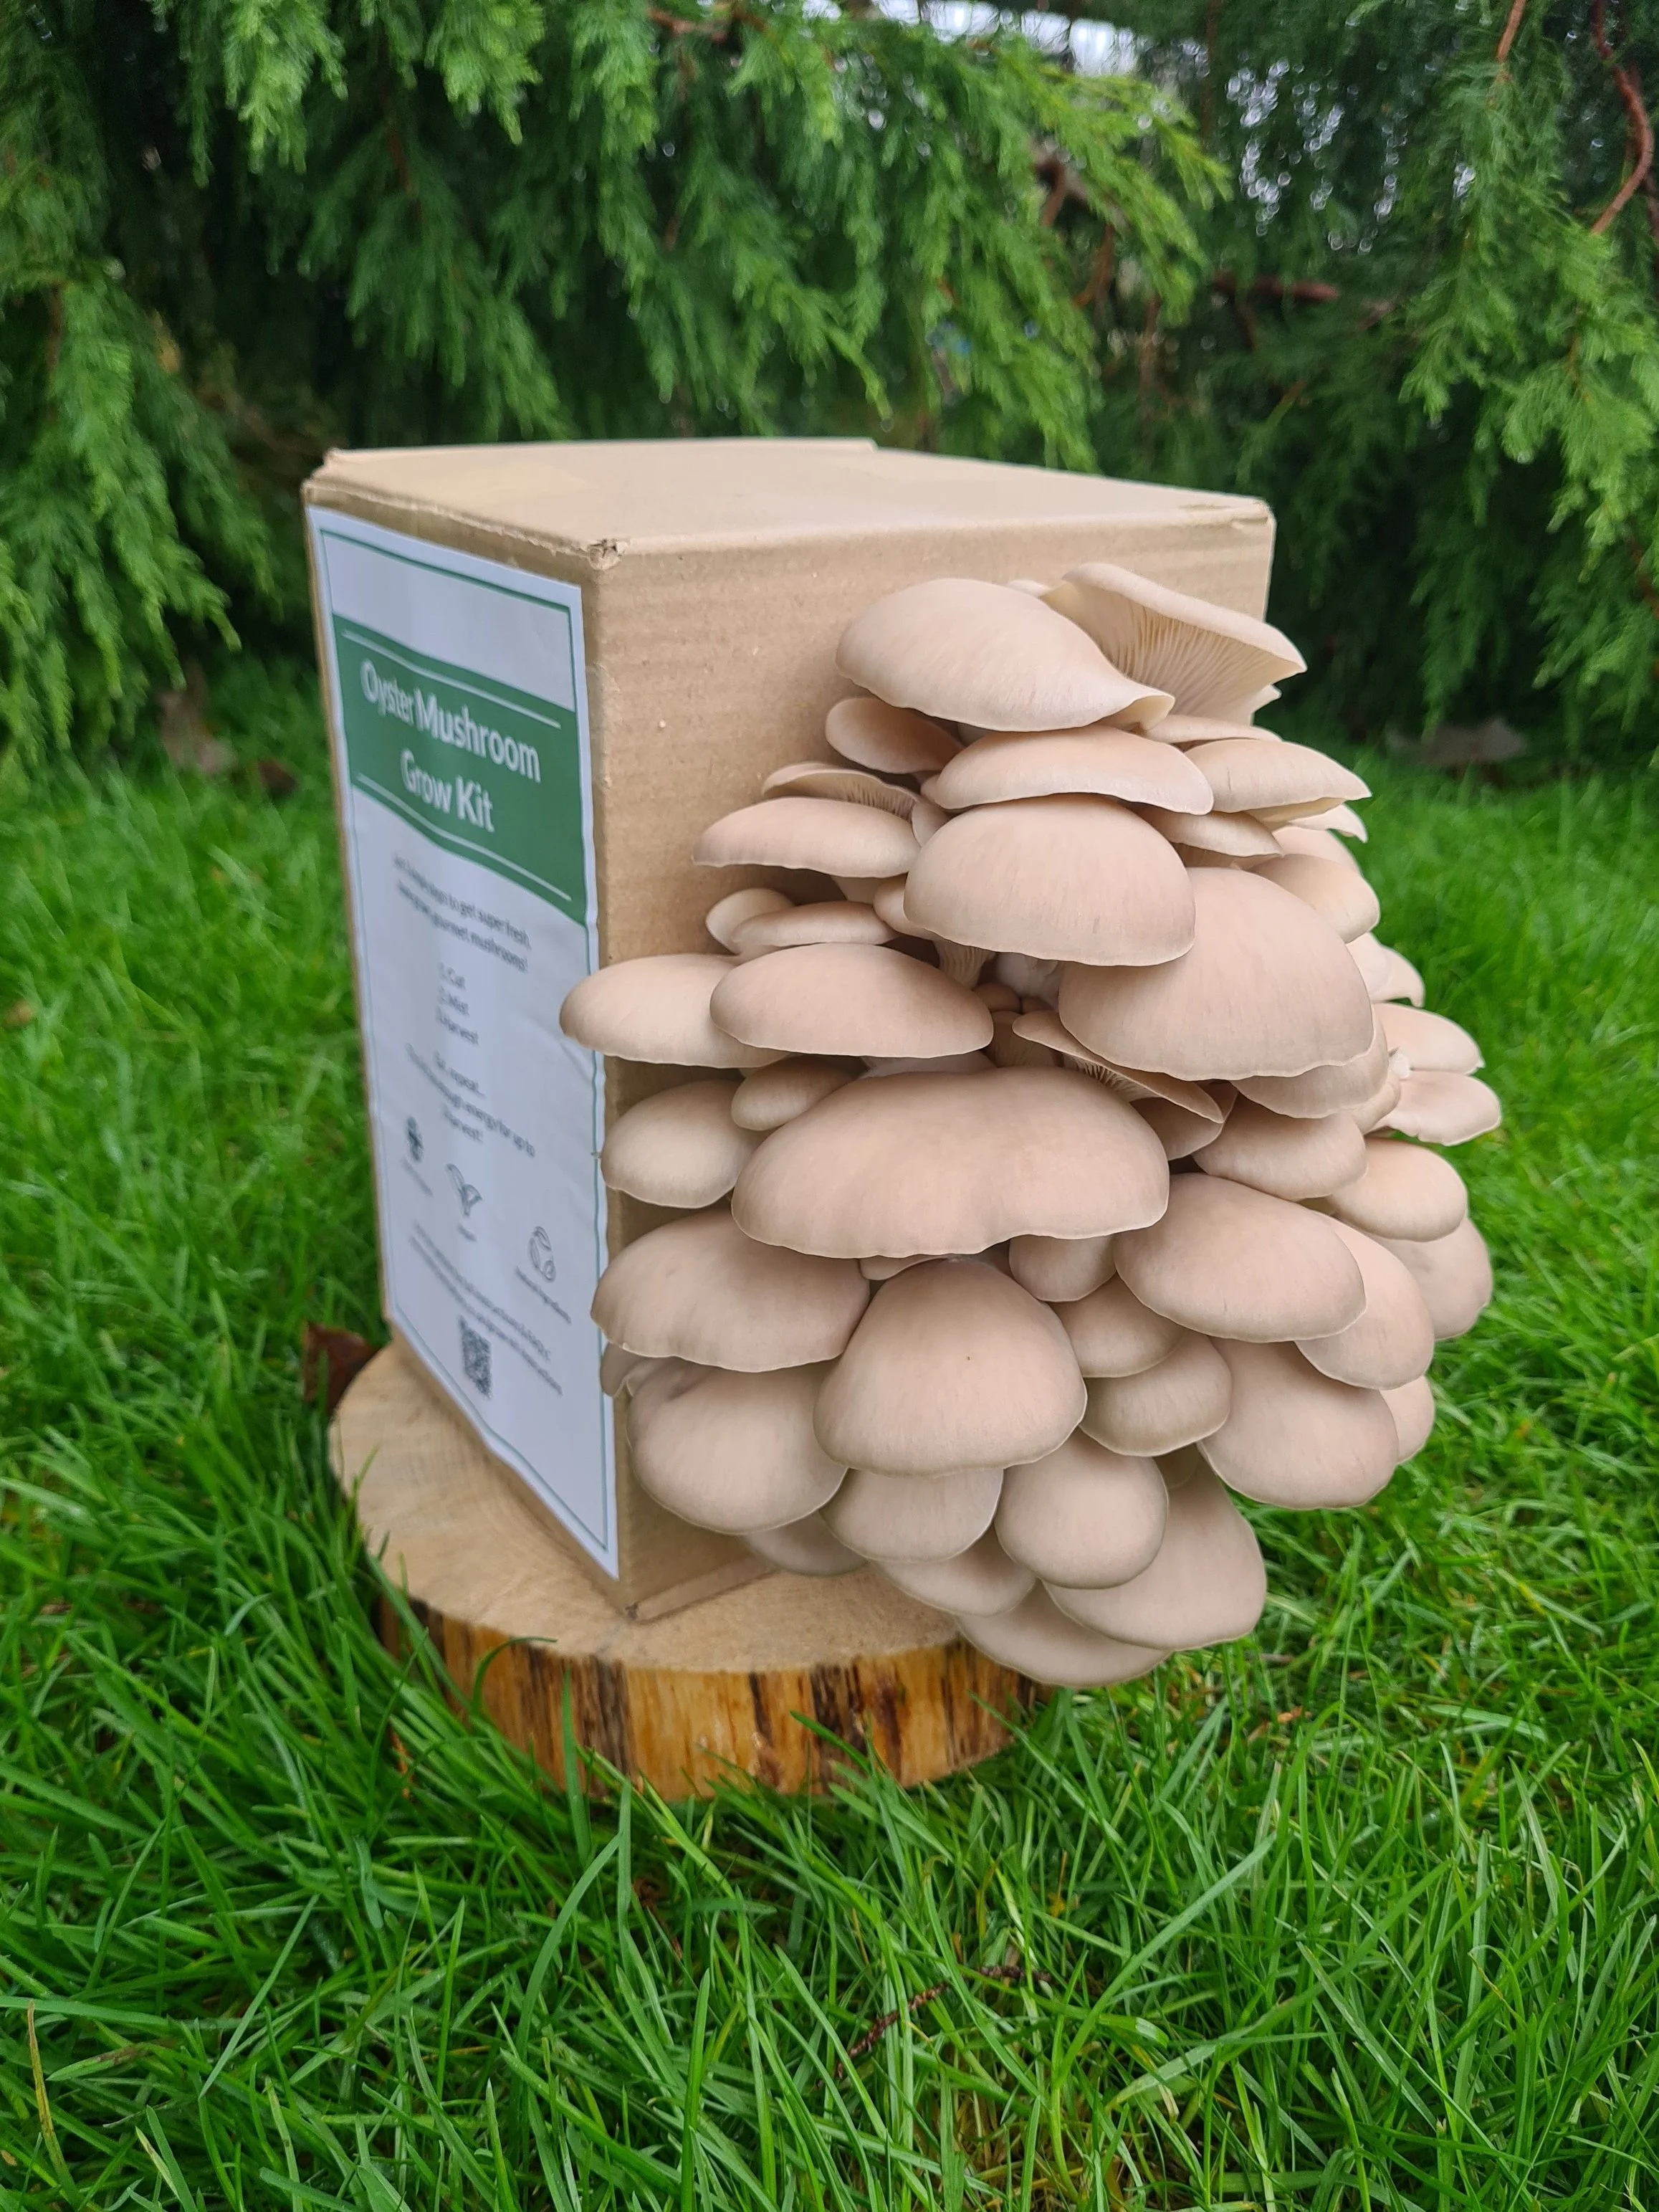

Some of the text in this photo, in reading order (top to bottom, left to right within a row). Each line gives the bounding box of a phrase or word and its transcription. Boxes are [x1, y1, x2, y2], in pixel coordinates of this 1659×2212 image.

[360, 659, 541, 783] Oyster Mushroom
[401, 748, 495, 833] Grow Kit
